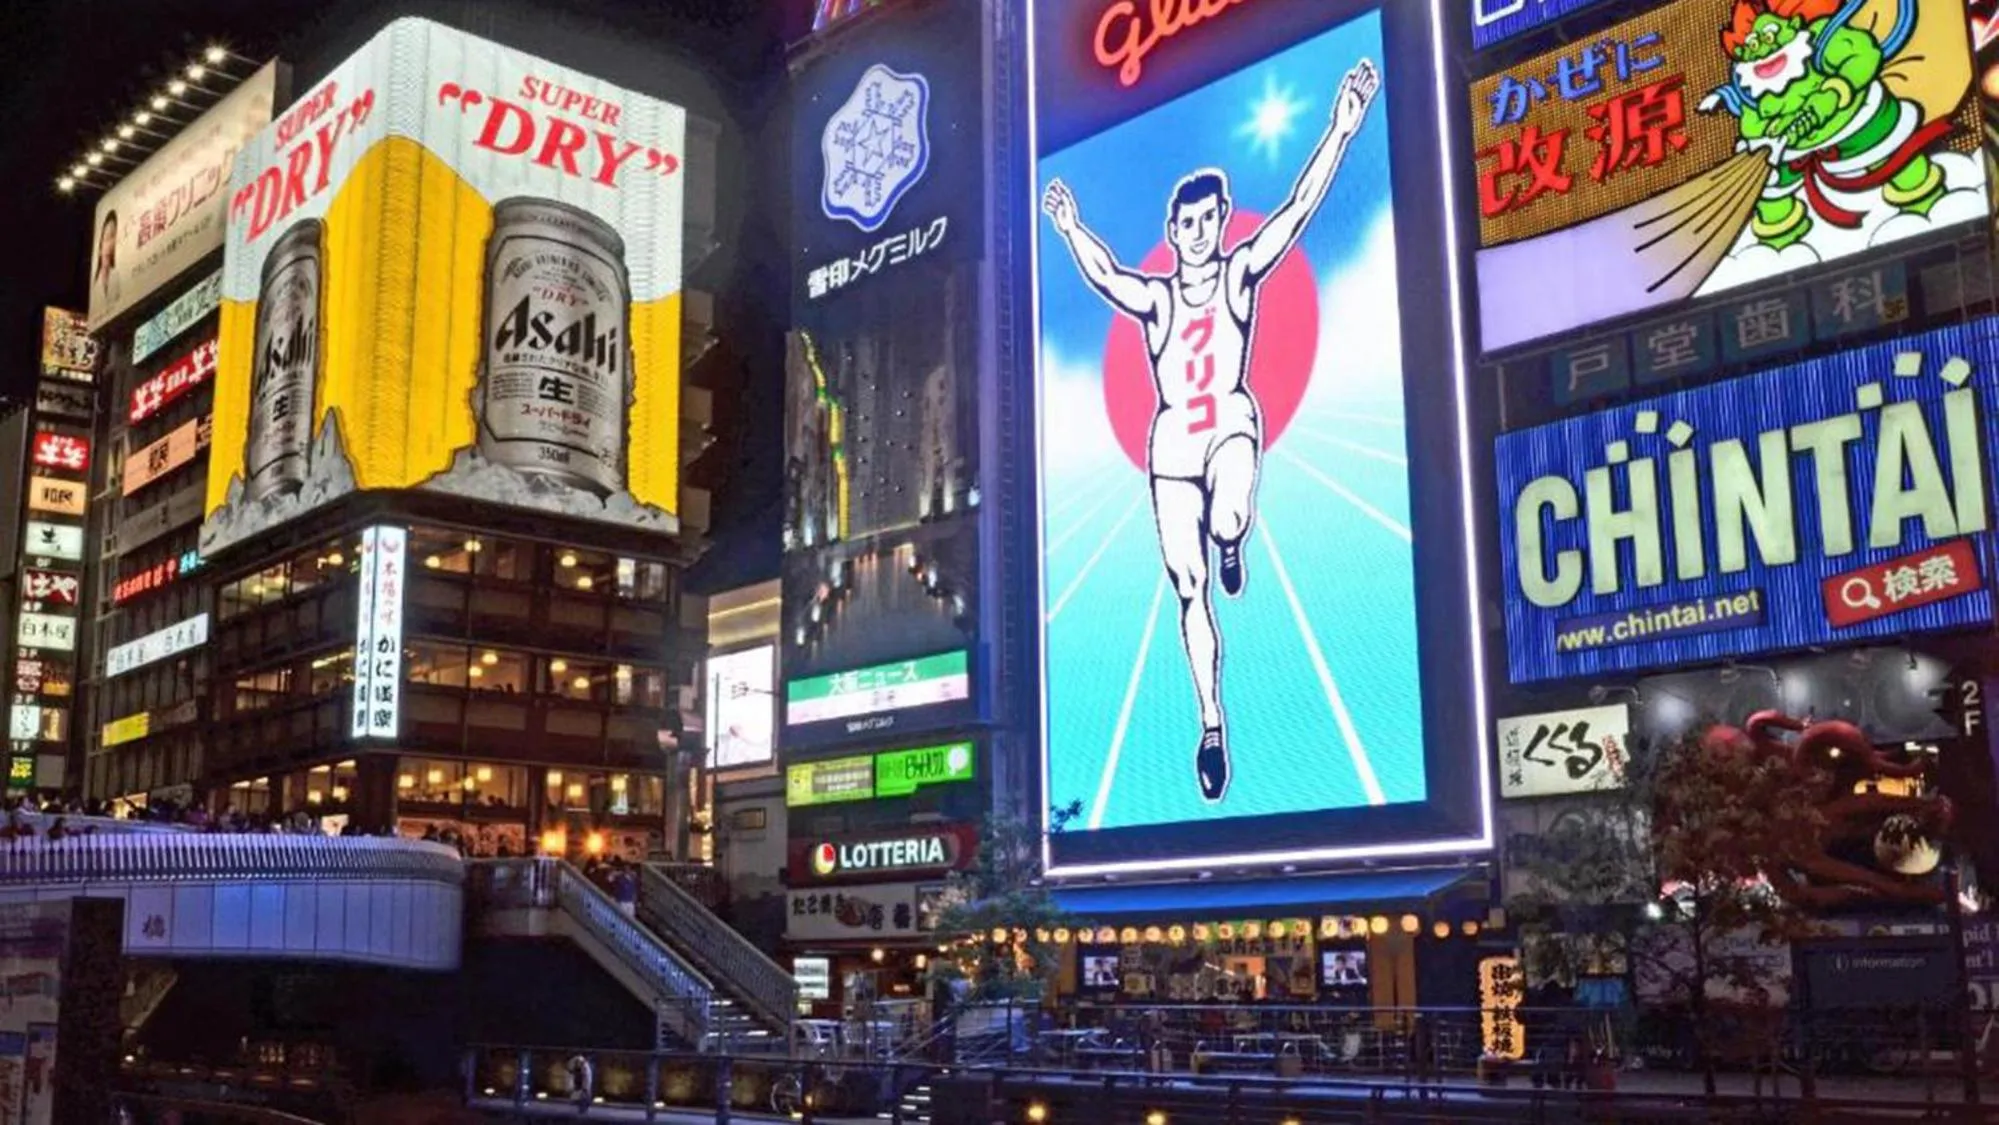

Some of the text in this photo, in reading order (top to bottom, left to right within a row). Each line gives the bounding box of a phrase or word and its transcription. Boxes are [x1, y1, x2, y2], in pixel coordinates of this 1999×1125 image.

[521, 74, 623, 127] SUPER
[1488, 30, 1663, 128] かぜに
[274, 80, 340, 150] SUPER
[1475, 75, 1692, 219] 改源
[807, 216, 948, 299] 雪印メグミルク
[495, 294, 617, 374] Asahi
[538, 376, 574, 406] 生
[1181, 307, 1218, 435] グリコ
[1883, 553, 1960, 602] 検索
[1522, 720, 1603, 780] くくる
[840, 836, 945, 869] LOTTERIA
